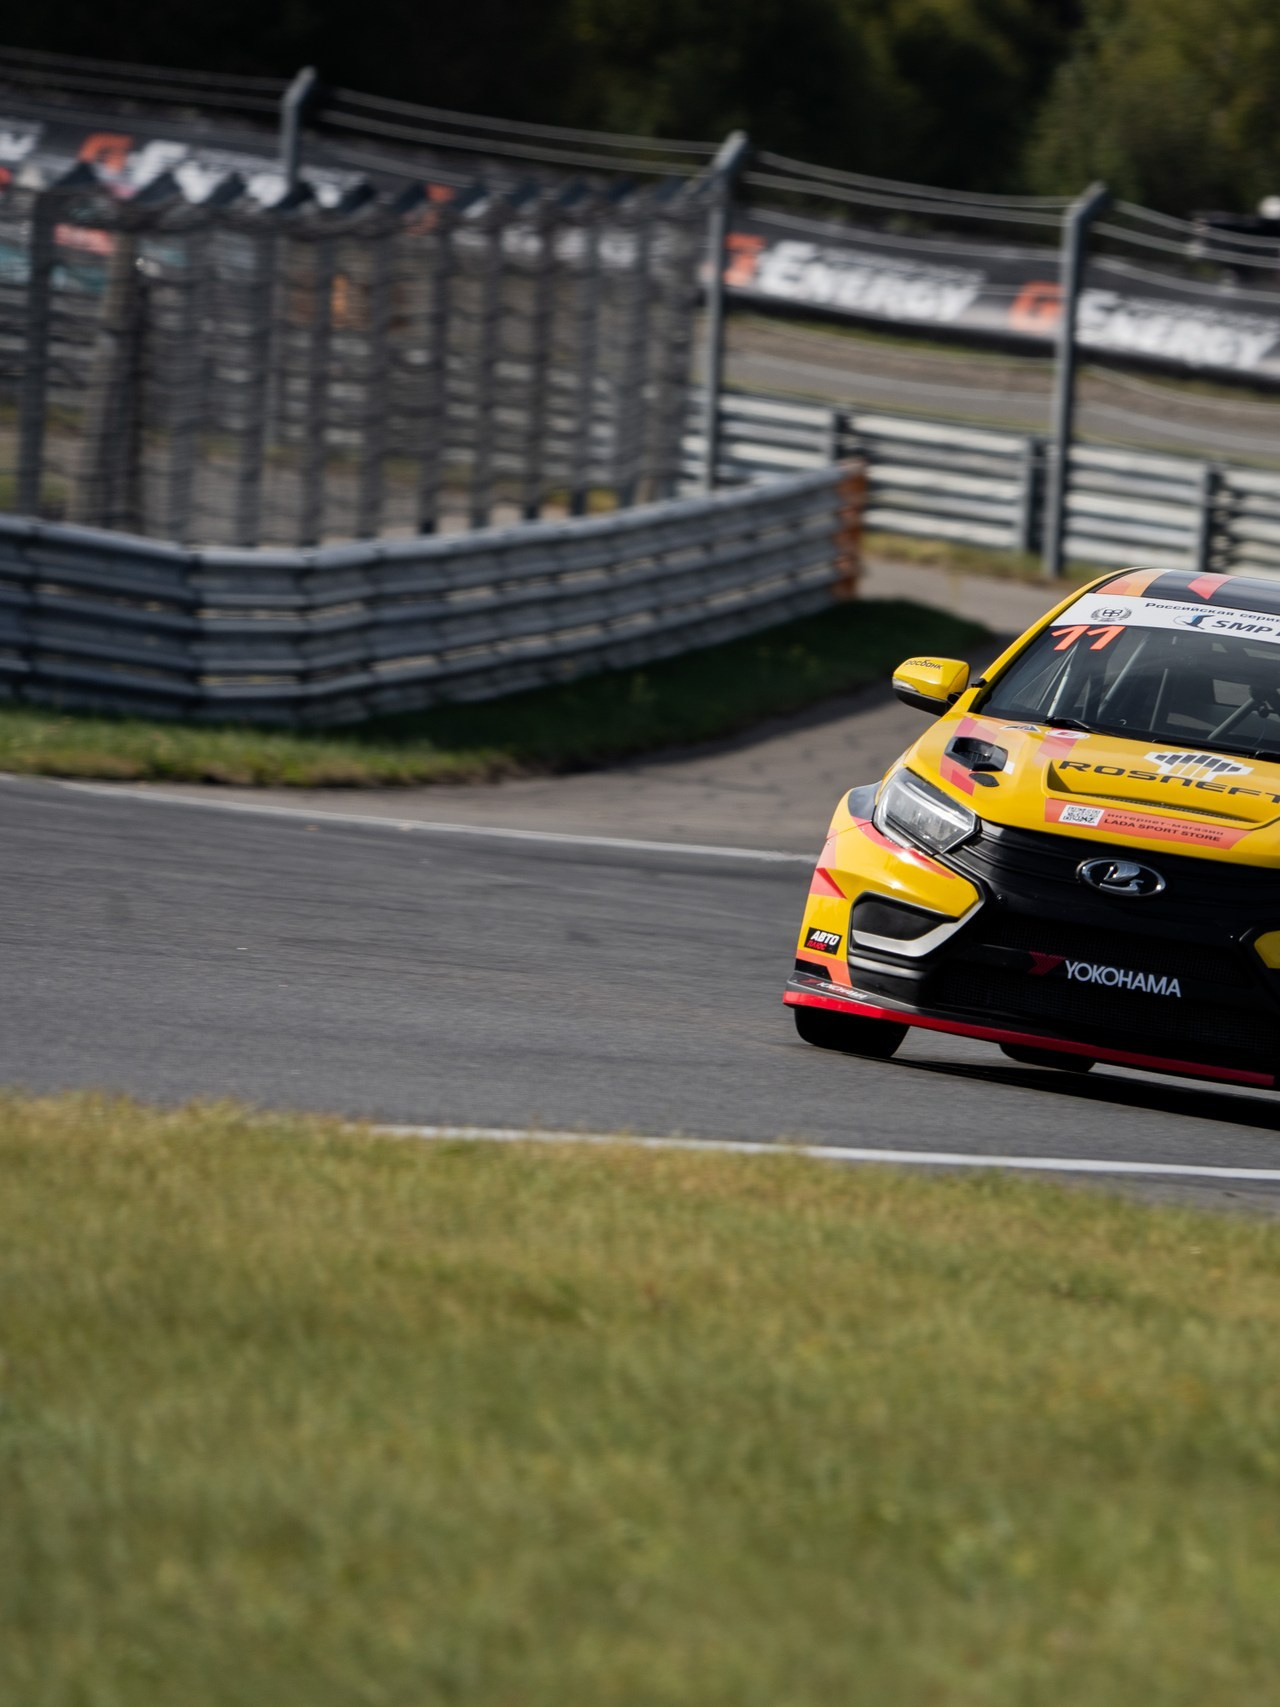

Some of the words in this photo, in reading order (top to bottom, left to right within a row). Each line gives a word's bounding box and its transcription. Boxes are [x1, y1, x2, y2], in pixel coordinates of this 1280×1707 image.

[1145, 602, 1235, 616] Российская
[1211, 620, 1273, 633] SMP
[1051, 624, 1126, 651] 11
[1104, 818, 1136, 828] LADA
[1138, 824, 1180, 835] SPORT
[1180, 831, 1222, 842] STORE
[810, 930, 840, 946] АВТО
[1065, 959, 1181, 998] YOKOHAMA
